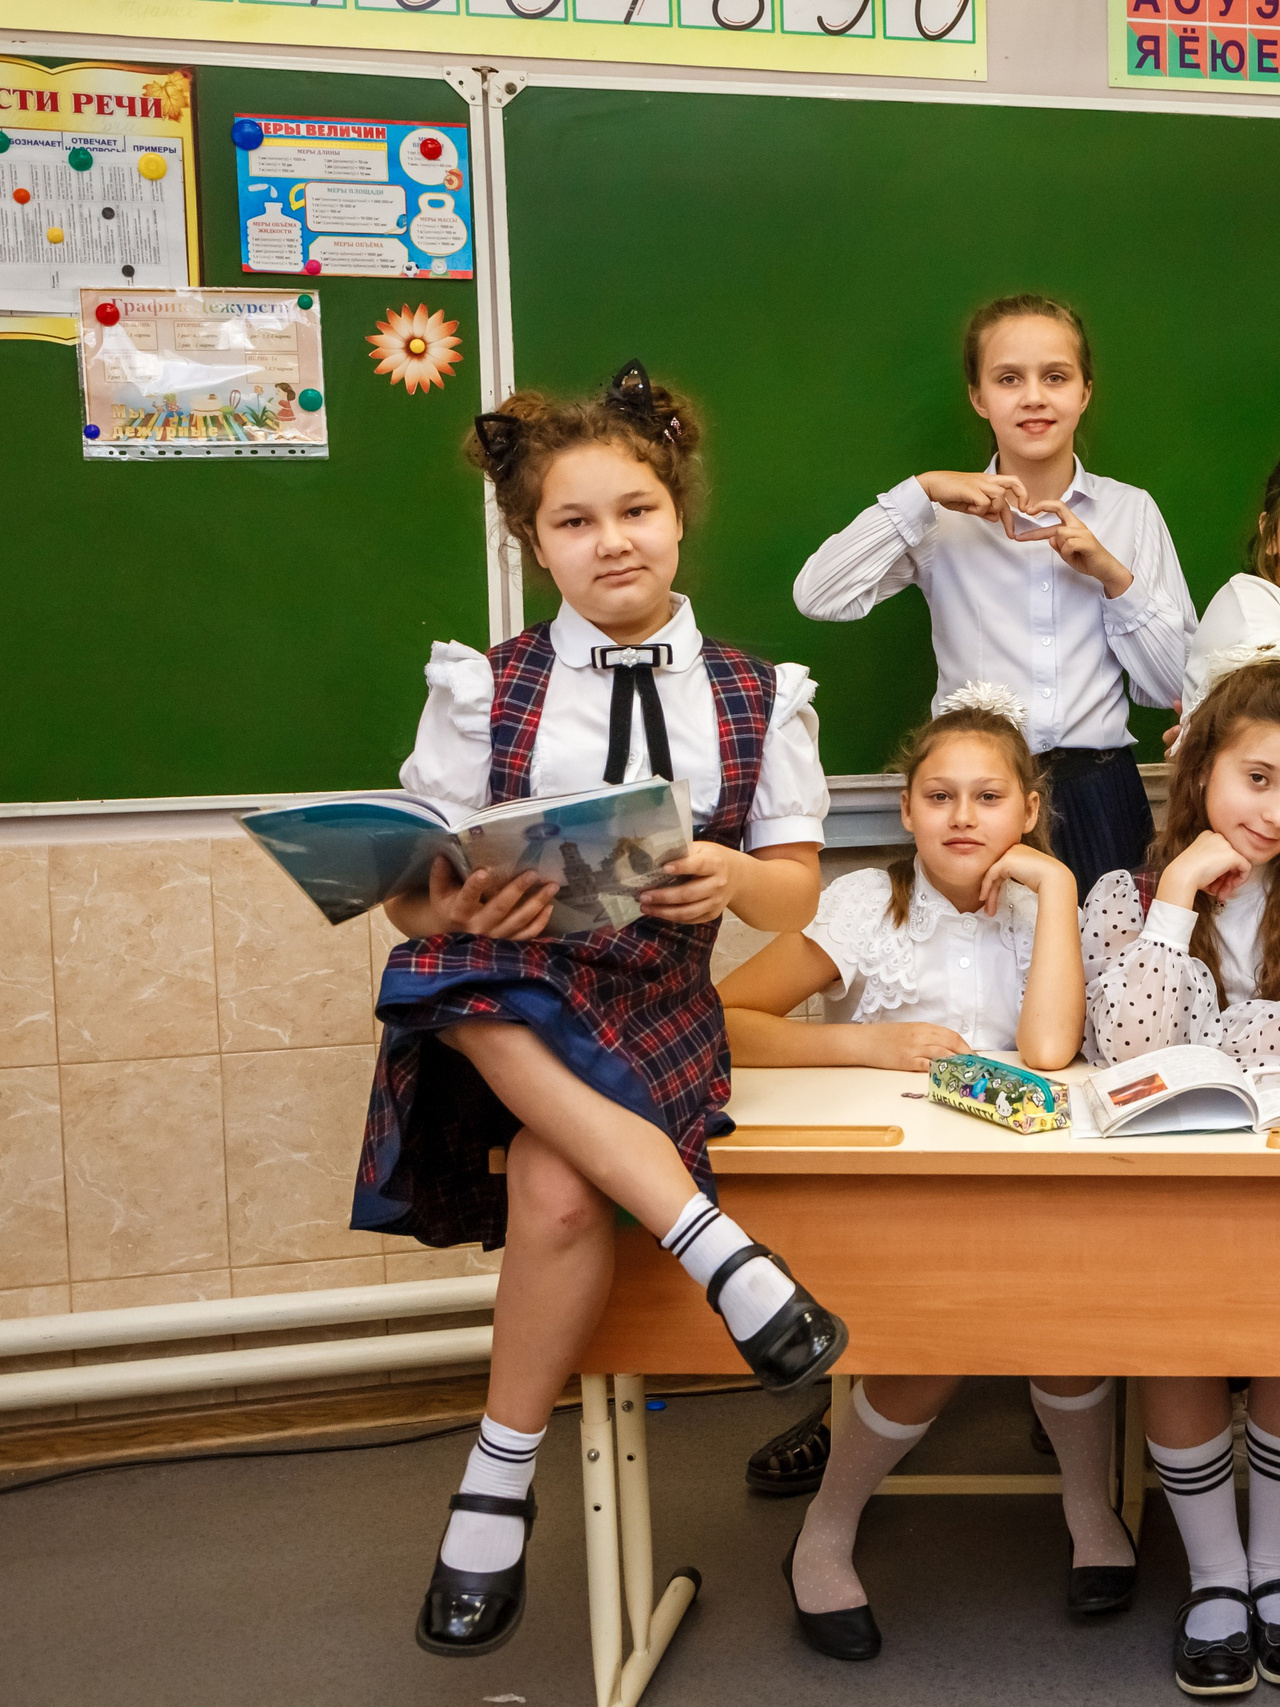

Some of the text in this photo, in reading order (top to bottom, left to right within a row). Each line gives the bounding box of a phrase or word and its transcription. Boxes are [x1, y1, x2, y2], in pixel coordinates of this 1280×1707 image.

[1135, 35, 1161, 70] Я
[1180, 27, 1201, 70] Ё
[1210, 38, 1246, 74] Ю
[1257, 38, 1279, 74] Е
[72, 92, 164, 119] РЕЧИ
[305, 123, 387, 140] ВЕЛИЧИН
[9, 138, 62, 148] БОЗНАЧАЕТ
[71, 137, 118, 147] ОТВЕЧАЕТ
[132, 144, 177, 154] ПРИМЕРЫ
[348, 188, 384, 196] ПЛОЩАДИ
[111, 404, 145, 419] Мы
[112, 425, 219, 442] дежурные
[967, 1104, 994, 1121] KITTY
